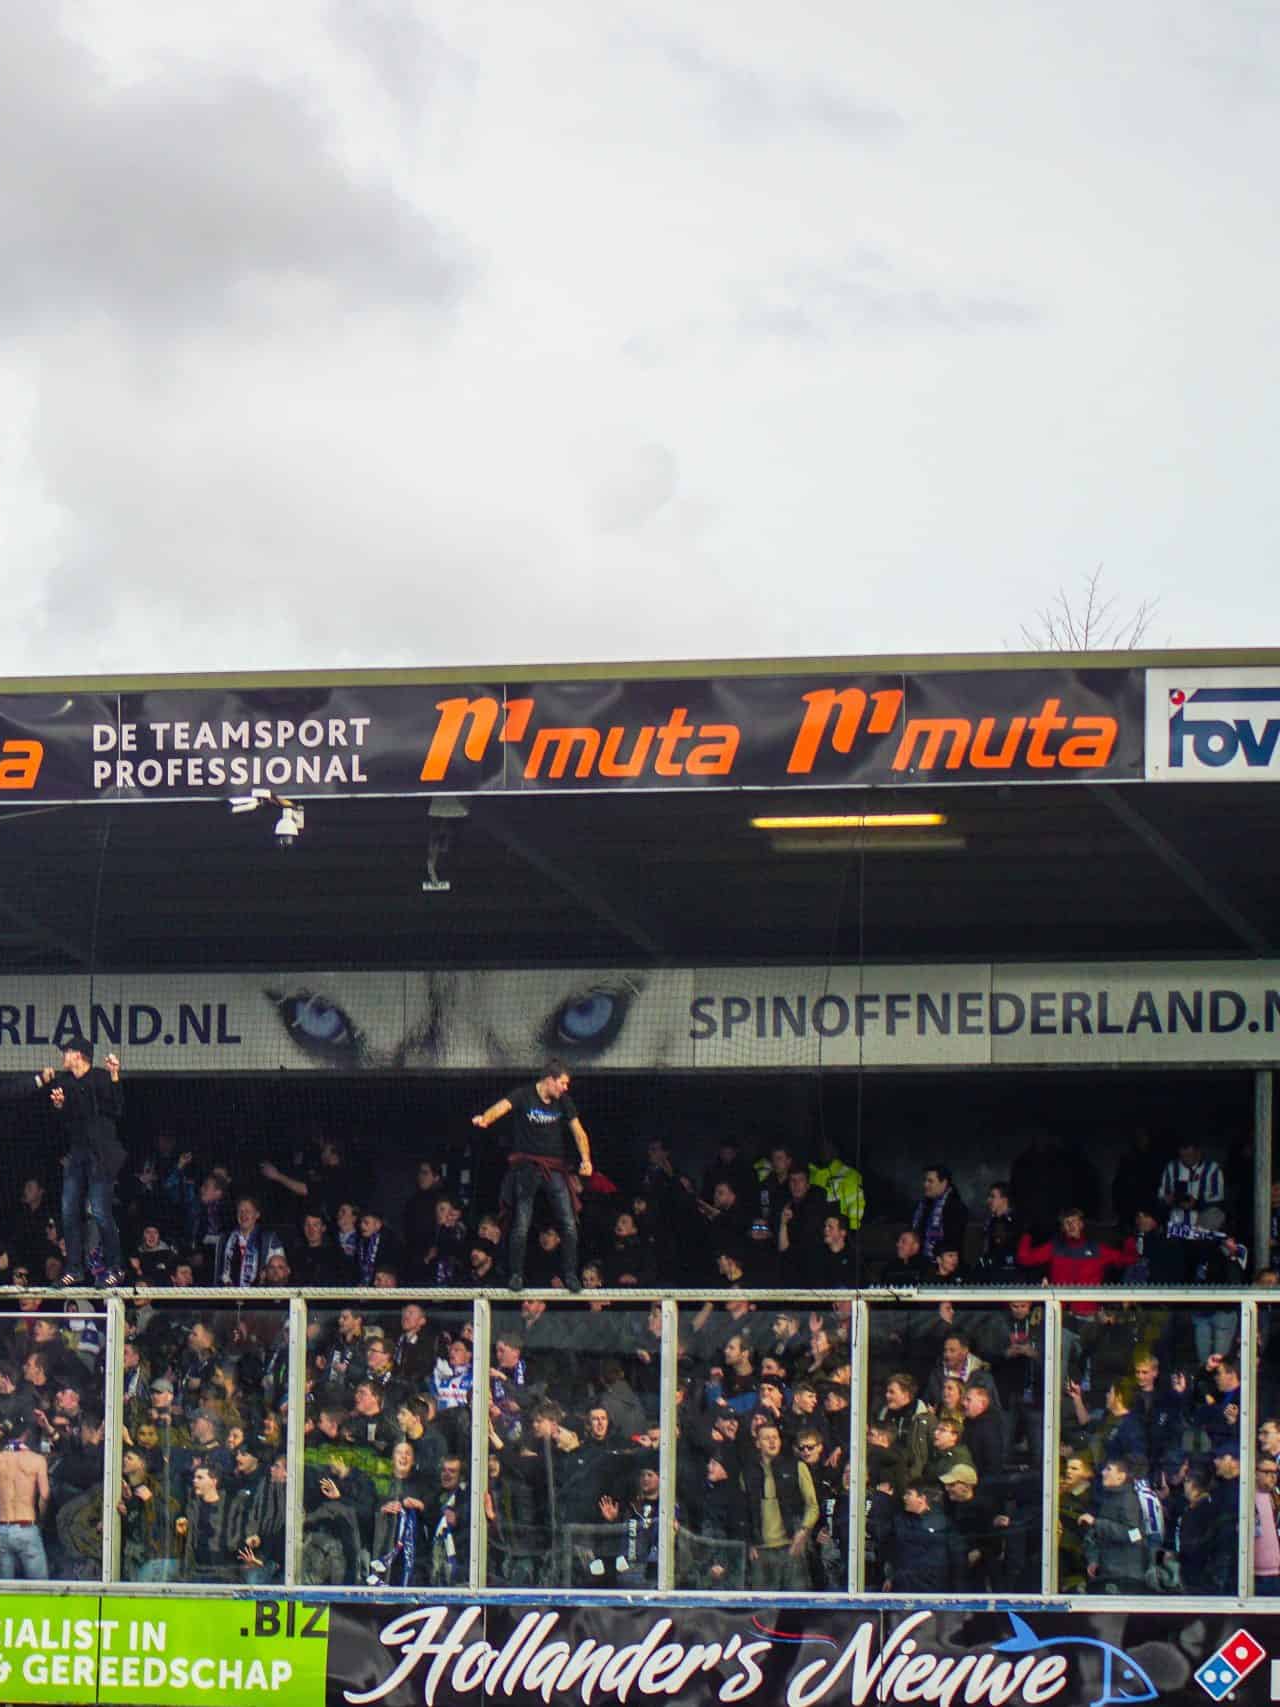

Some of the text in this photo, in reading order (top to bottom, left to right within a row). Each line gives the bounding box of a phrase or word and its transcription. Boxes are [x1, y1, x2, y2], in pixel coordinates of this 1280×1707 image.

[93, 718, 370, 752] DE TEAMSPORT
[523, 708, 741, 779] muta
[891, 698, 1118, 771] muta
[93, 755, 368, 788] PROFESSIONAL
[128, 1621, 167, 1651] IN
[240, 1600, 329, 1639] .BIZ
[22, 1656, 293, 1690] GEREEDSCHAP
[343, 1606, 1068, 1707] Hollander's Nieuwe
